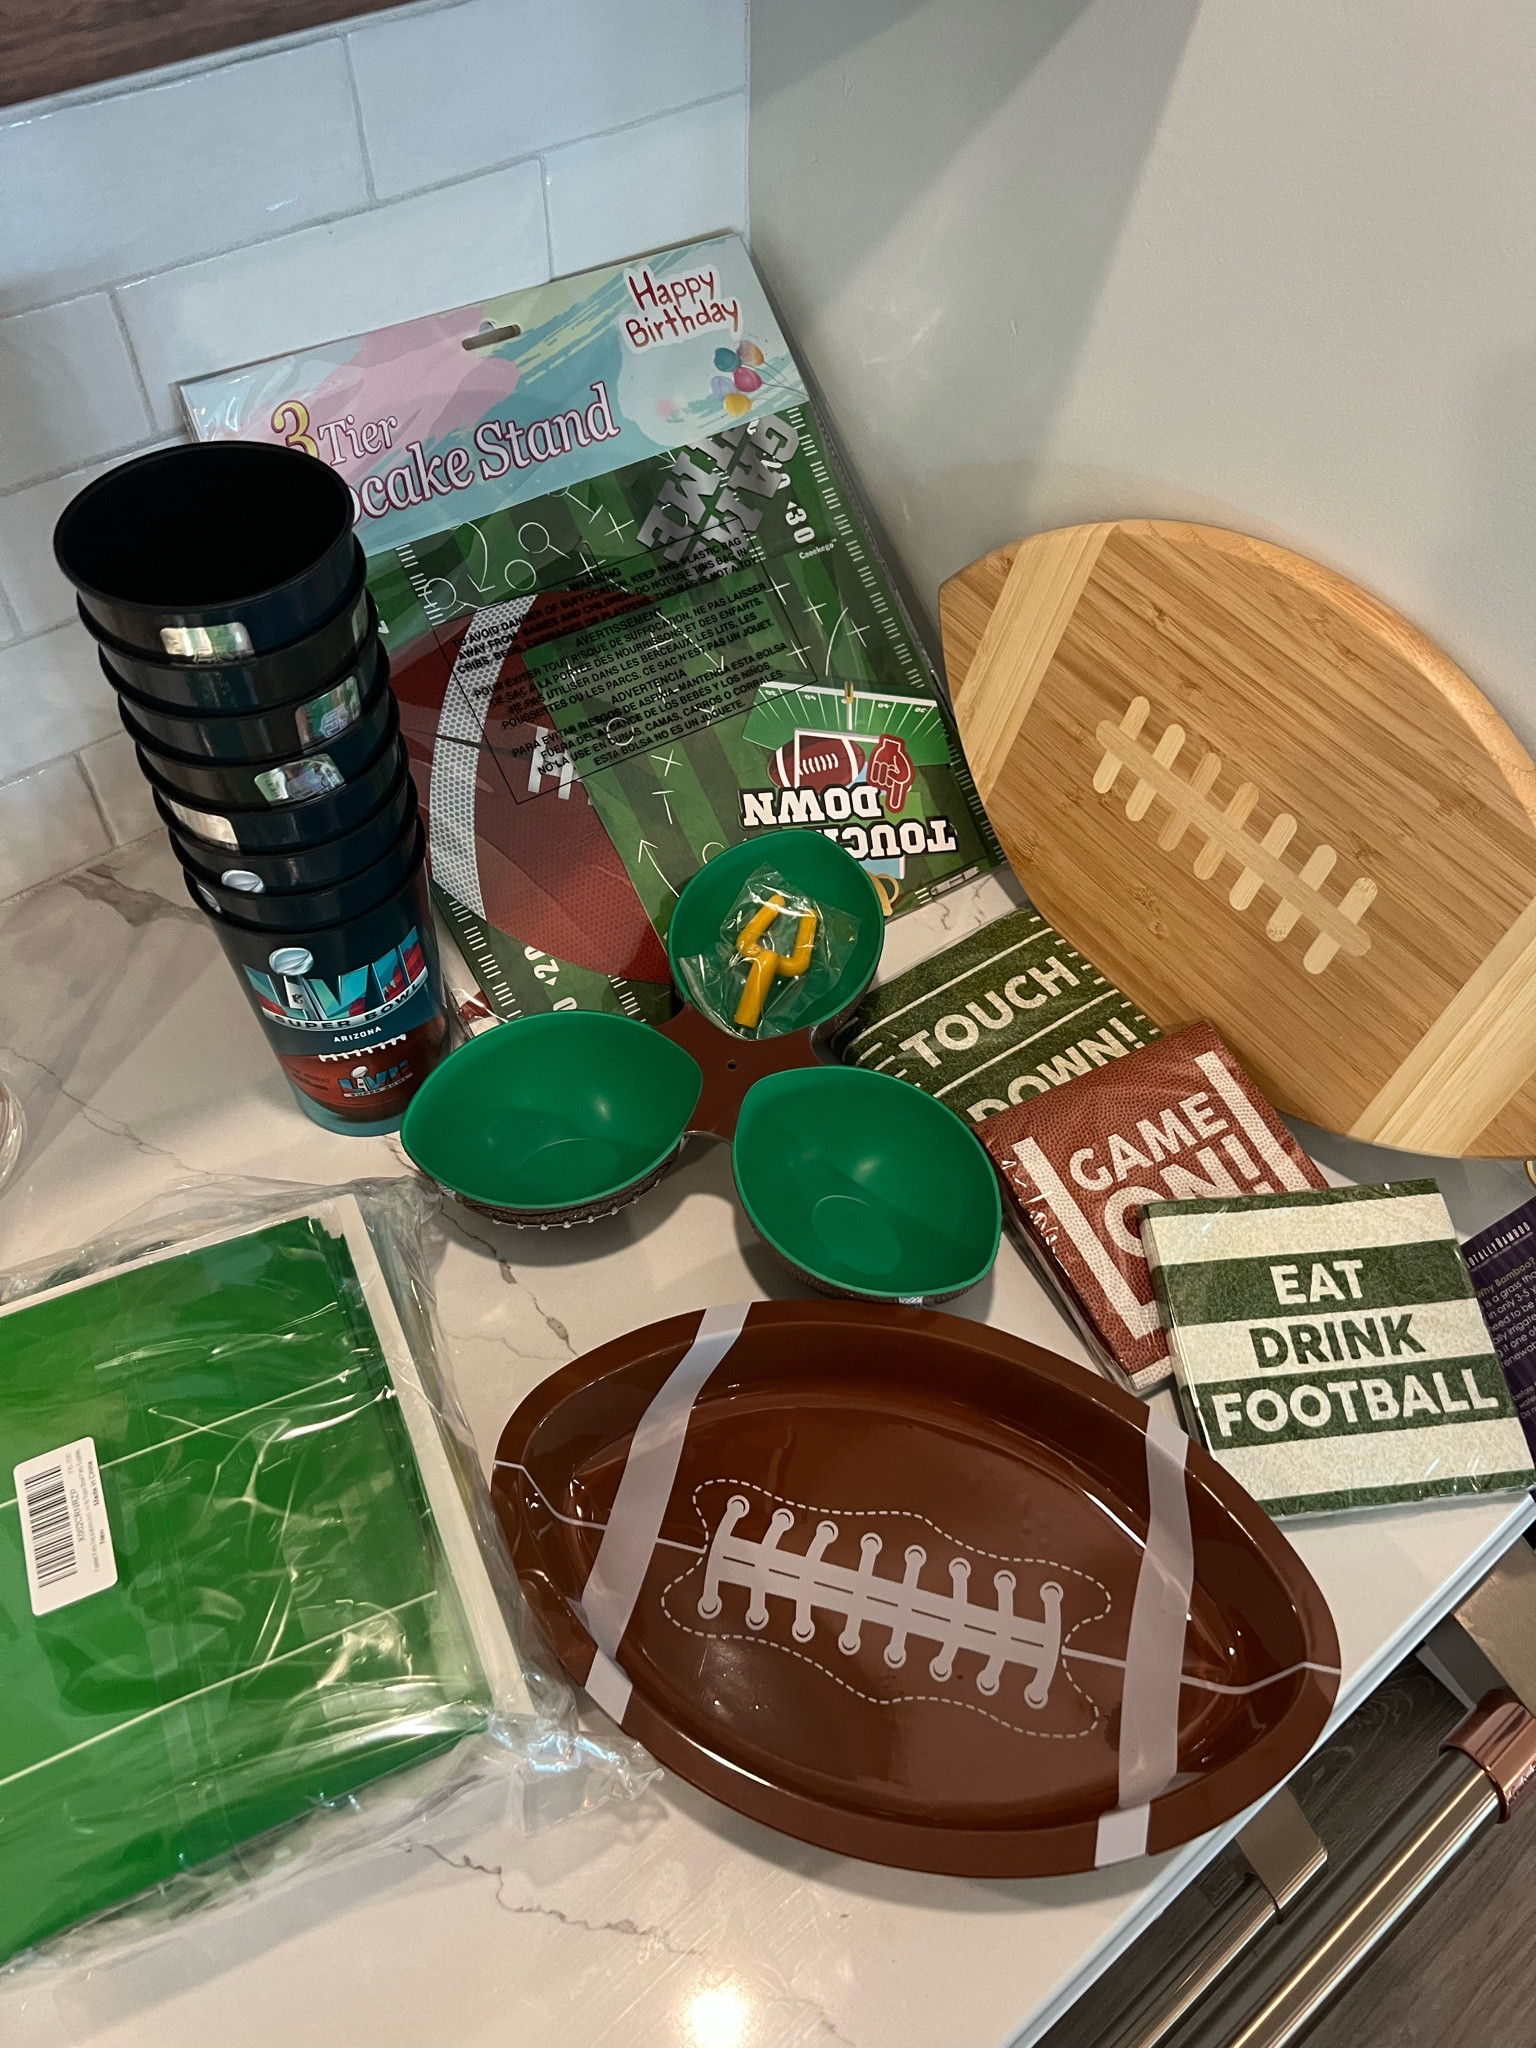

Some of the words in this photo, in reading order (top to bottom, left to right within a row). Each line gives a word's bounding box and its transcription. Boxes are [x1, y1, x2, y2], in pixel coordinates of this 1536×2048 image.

[628, 271, 714, 311] Happy
[625, 299, 739, 347] Birthday
[317, 414, 398, 467] Tier
[474, 381, 621, 480] Stand
[457, 643, 486, 659] AWAY
[487, 632, 517, 648] FROM
[636, 584, 649, 594] DO
[651, 576, 671, 589] NOT
[673, 569, 691, 581] USE
[716, 553, 735, 565] BAG
[737, 549, 747, 557] IN
[468, 625, 499, 641] AVOID
[500, 609, 542, 630] DANGER
[544, 603, 559, 614] OF
[631, 569, 656, 583] KEEP
[658, 560, 679, 573] THIS
[680, 546, 719, 565] PLASTIC
[722, 538, 741, 550] BAG
[568, 567, 621, 592] WARNING
[656, 586, 679, 600] THIS
[680, 580, 698, 591] BAG
[699, 576, 709, 584] IS
[710, 568, 729, 580] NOT
[730, 565, 738, 573] A
[474, 682, 503, 698] POUR
[542, 657, 569, 672] TOUT
[570, 642, 607, 661] RISQUE
[608, 637, 622, 647] DE
[693, 605, 705, 615] NE
[708, 598, 726, 610] PAS
[727, 583, 765, 602] LAISSER
[506, 687, 526, 700] SAC
[537, 678, 551, 688] LA
[594, 654, 613, 666] DES
[615, 628, 683, 658] NOURRISSONS
[685, 622, 697, 631] ET
[699, 615, 717, 626] DES
[719, 597, 762, 618] ENFANTS.
[574, 607, 663, 646] AVERTISSEMENT
[502, 699, 567, 729] POUSSETTES
[569, 692, 584, 703] OU
[585, 684, 604, 697] LES
[605, 670, 640, 689] PARCS.
[642, 664, 656, 674] CE
[657, 656, 676, 669] SAC
[708, 636, 728, 648] PAS
[730, 631, 740, 640] UN
[742, 619, 773, 635] JOUET.
[546, 677, 590, 699] UTILISER
[592, 666, 618, 681] DANS
[621, 658, 638, 670] LES
[696, 629, 713, 641] LES
[715, 620, 737, 634] LITS,
[739, 613, 756, 624] LES
[512, 740, 540, 756] PARA
[542, 725, 576, 744] EVITAR
[578, 708, 621, 729] RIESGOS
[622, 702, 636, 712] DE
[678, 664, 729, 689] MANTENGA
[731, 654, 754, 668] ESTA
[756, 641, 786, 658] BOLSA
[611, 668, 686, 703] ADVERTENCIA
[538, 763, 553, 774] NO
[555, 757, 569, 767] LA
[571, 748, 591, 761] USE
[593, 741, 607, 752] EN
[682, 694, 721, 715] CARROS
[541, 740, 575, 759] FUERA
[577, 732, 595, 744] DEL
[597, 713, 642, 736] ALCANCE
[643, 707, 657, 717] DE
[659, 698, 678, 711] LOS
[678, 684, 711, 703] BEBÉS
[720, 674, 739, 686] LOS
[594, 750, 619, 765] ESTA
[621, 736, 652, 754] BOLSA
[654, 730, 668, 740] NO
[670, 723, 683, 734] ES
[684, 718, 698, 728] UN
[742, 785, 882, 827] DOWN
[815, 819, 957, 859] TOUC
[273, 1013, 351, 1031] SUPER
[363, 978, 423, 1022] BOWL
[899, 955, 1081, 1068] TOUCH
[333, 1025, 383, 1044] ARIZONA
[1069, 1091, 1229, 1192] GAME
[1269, 1259, 1364, 1305] EAT
[1494, 1256, 1536, 1288] Bamboo?
[1499, 1280, 1523, 1300] grass
[1487, 1309, 1497, 1320] in
[1497, 1298, 1516, 1313] only
[1514, 1288, 1530, 1302] 3-5
[1510, 1310, 1521, 1318] to
[1520, 1300, 1535, 1312] be
[1249, 1313, 1427, 1369] DRINK
[1510, 1333, 1528, 1348] one
[1211, 1368, 1499, 1438] FOOTBALL
